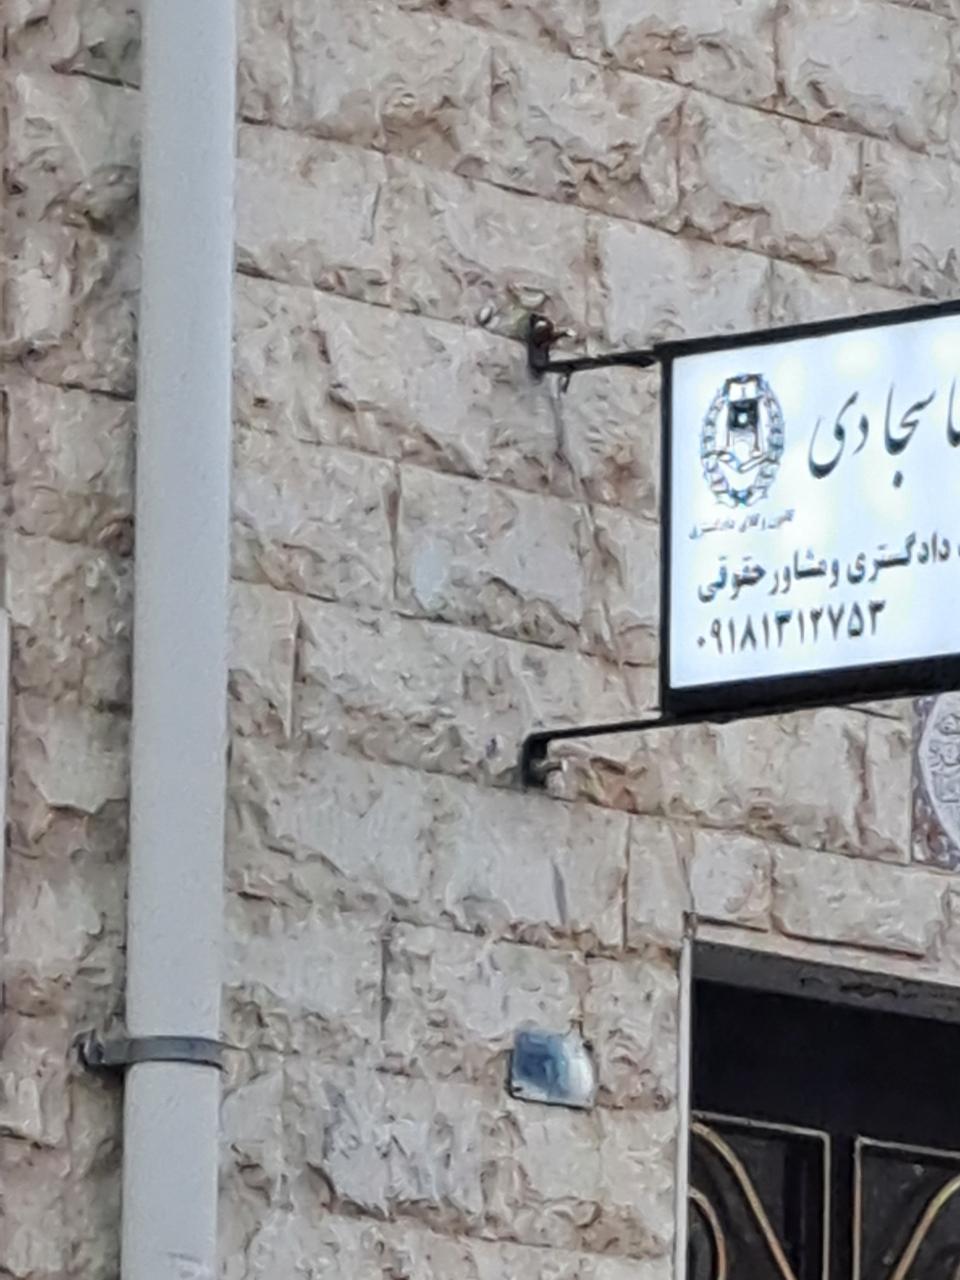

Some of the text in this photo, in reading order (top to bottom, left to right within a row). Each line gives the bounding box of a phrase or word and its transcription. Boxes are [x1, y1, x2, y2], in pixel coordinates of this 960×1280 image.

[808, 383, 936, 489] سجادی
[698, 555, 767, 604] حقوقی
[846, 532, 951, 585] دادگستری
